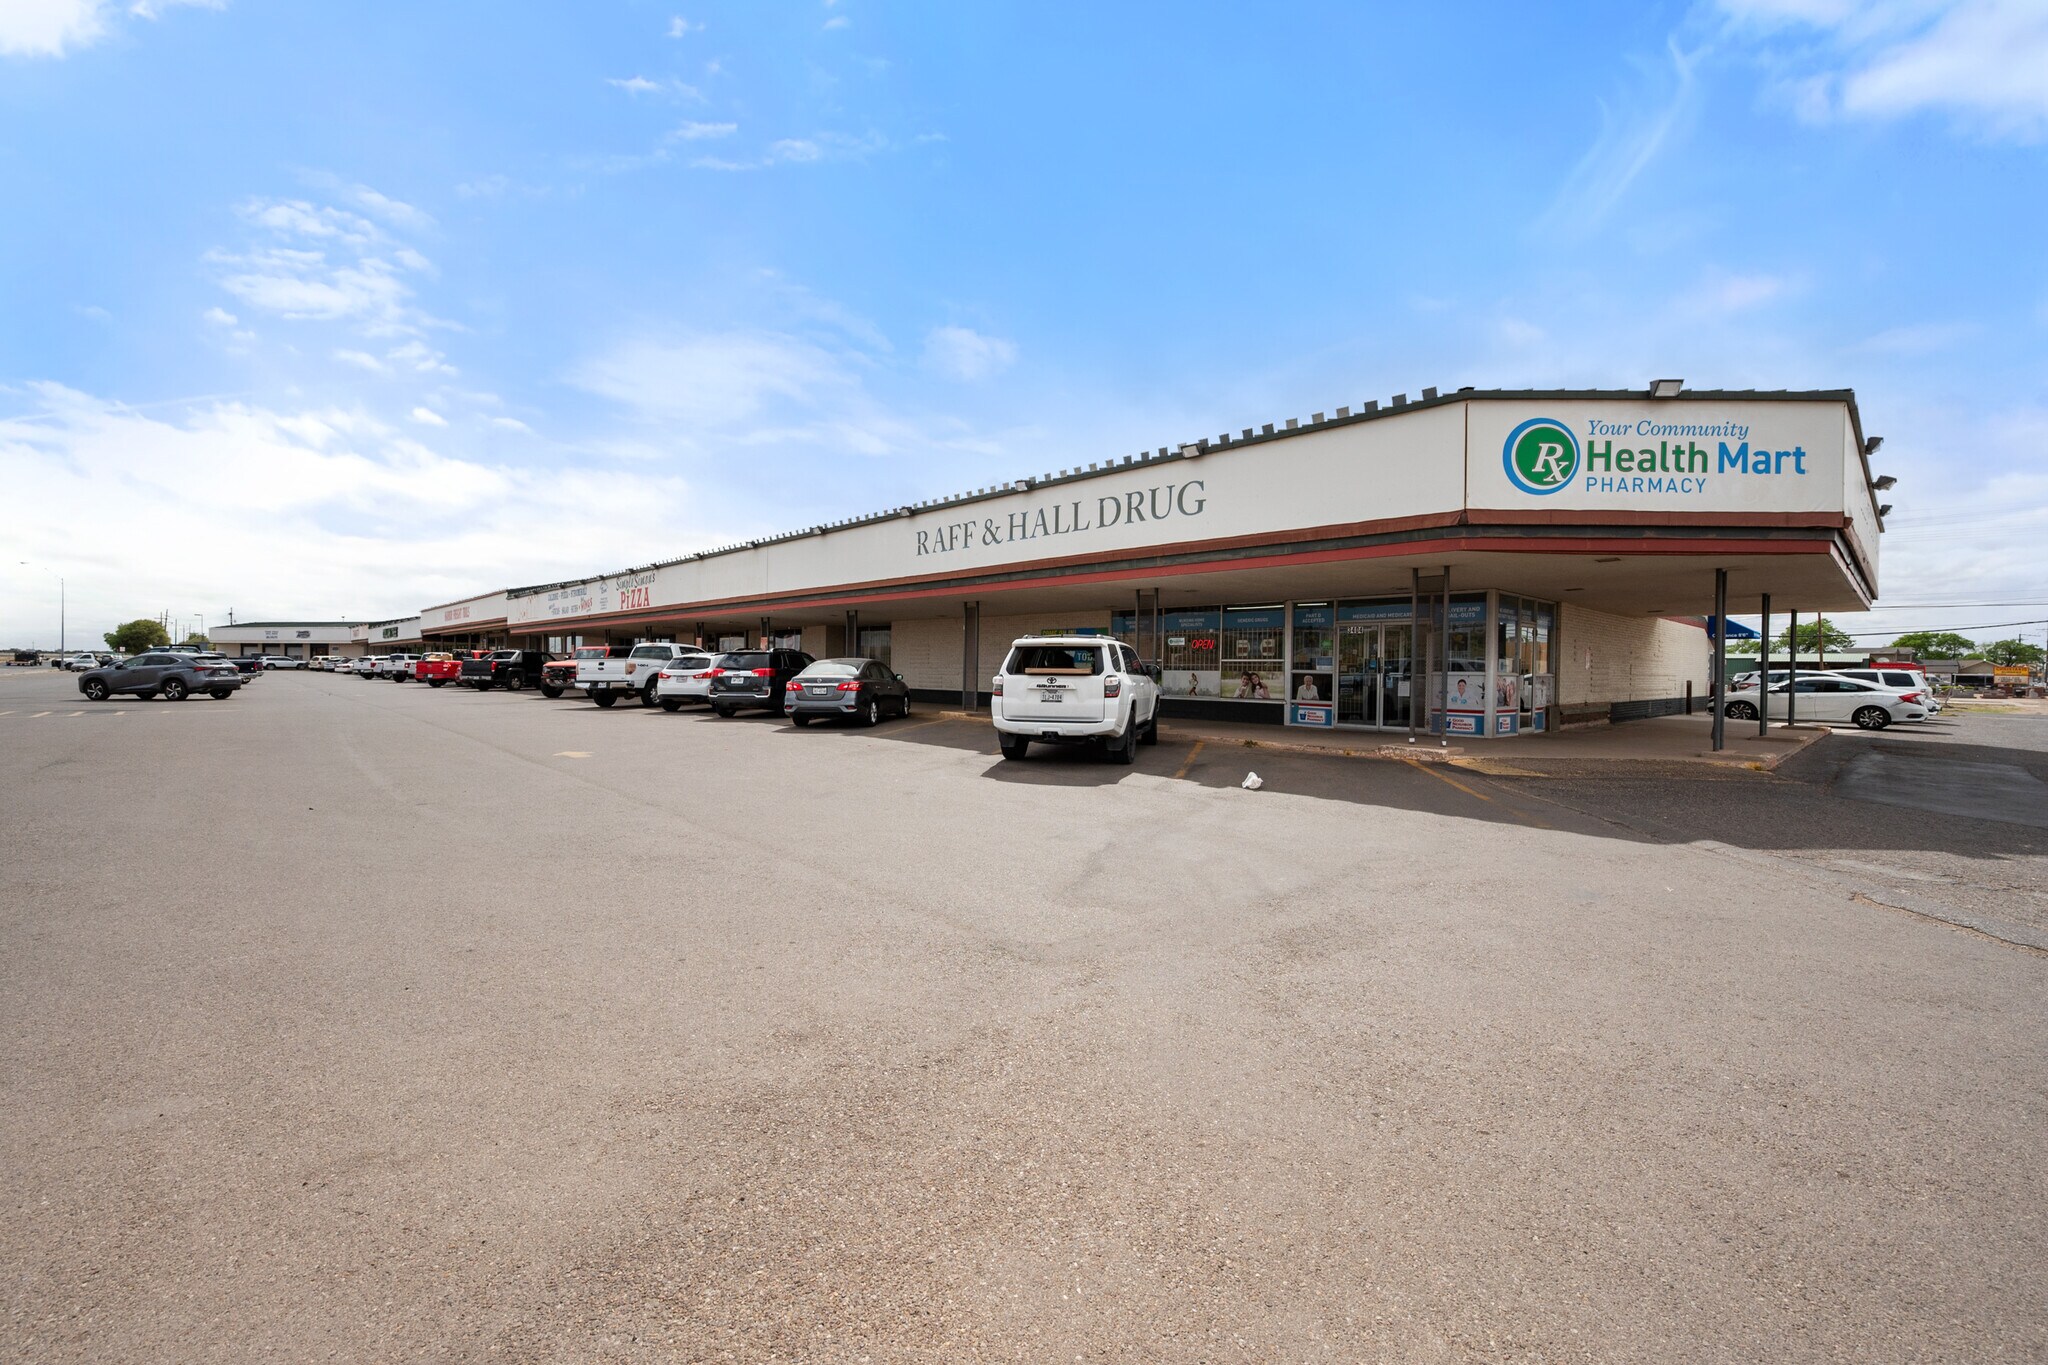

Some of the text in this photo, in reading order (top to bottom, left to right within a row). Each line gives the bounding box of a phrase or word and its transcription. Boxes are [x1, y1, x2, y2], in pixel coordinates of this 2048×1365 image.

[1588, 420, 1749, 440] Your Community
[1586, 440, 1806, 475] Health Mart
[1586, 477, 1707, 493] PHARMACY
[916, 480, 1207, 556] RAFF & HALL DRUG
[616, 574, 634, 591] Simple
[1191, 639, 1215, 650] OPEN
